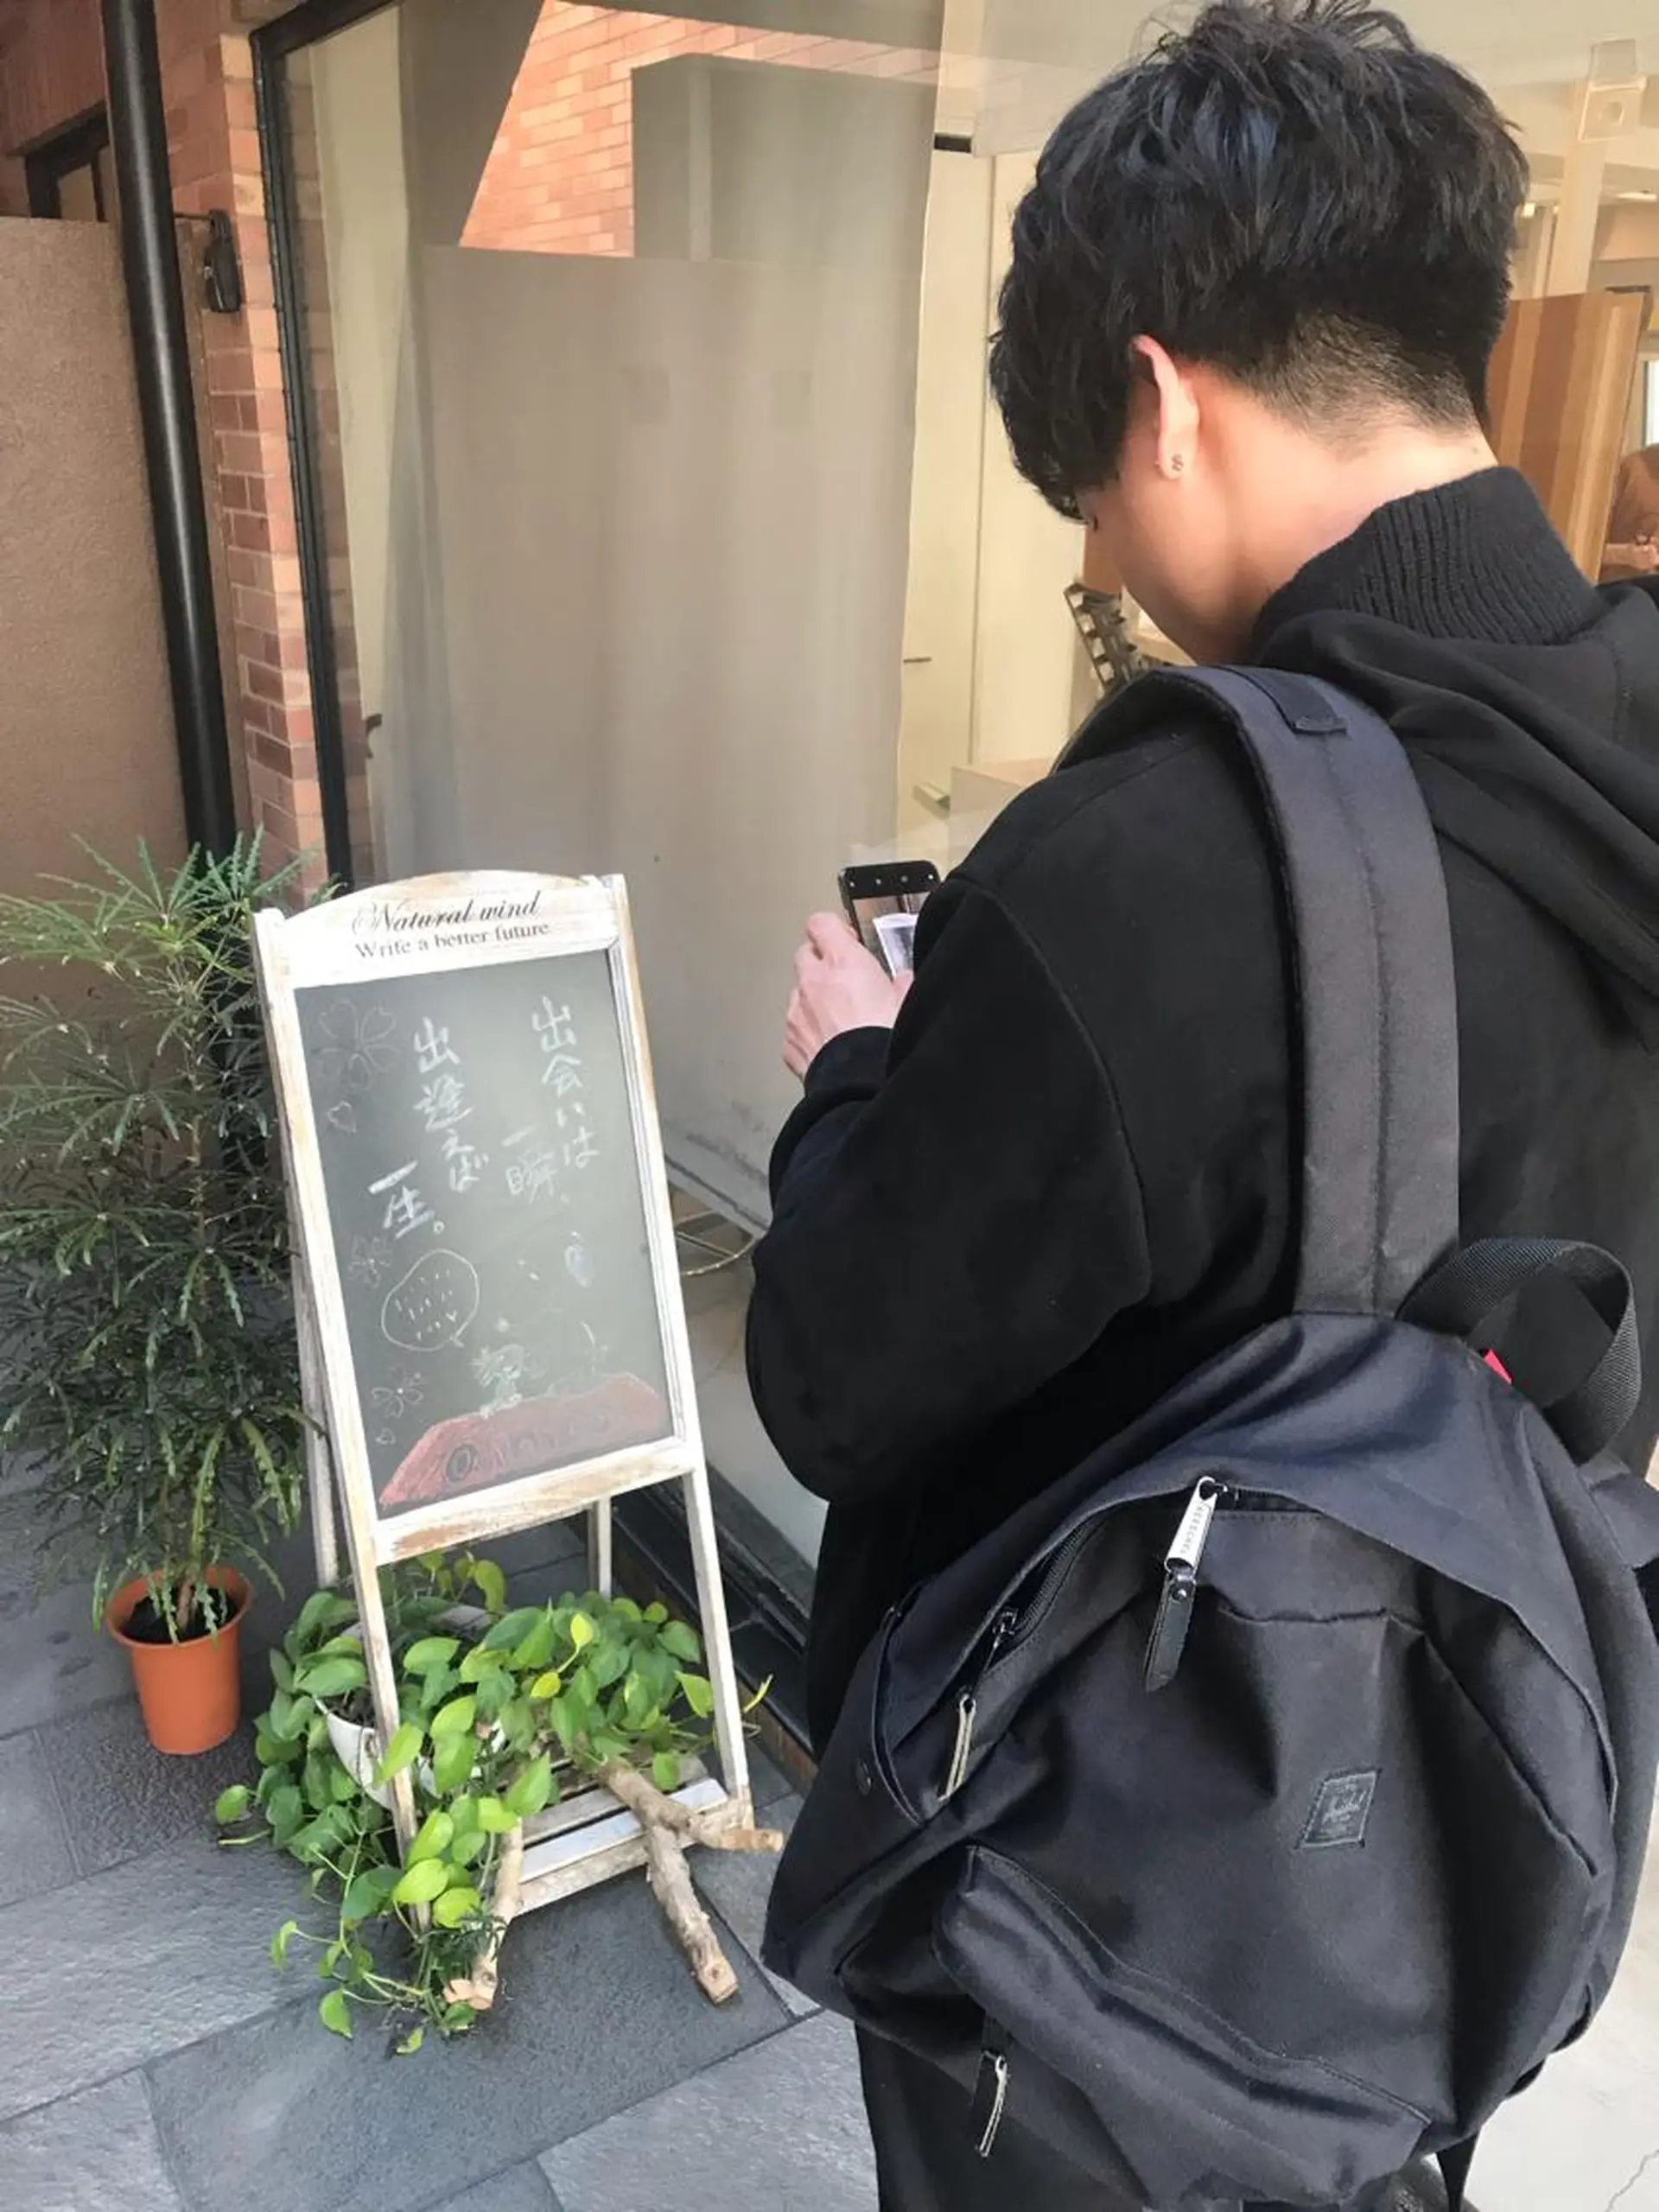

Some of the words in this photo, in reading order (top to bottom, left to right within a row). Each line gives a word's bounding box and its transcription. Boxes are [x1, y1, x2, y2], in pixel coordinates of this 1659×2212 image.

[352, 898, 474, 936] Natural
[480, 889, 542, 920] wind
[355, 940, 410, 958] Write
[417, 939, 430, 951] a
[434, 931, 488, 948] better
[495, 924, 551, 941] future
[531, 995, 602, 1170] 出会いは
